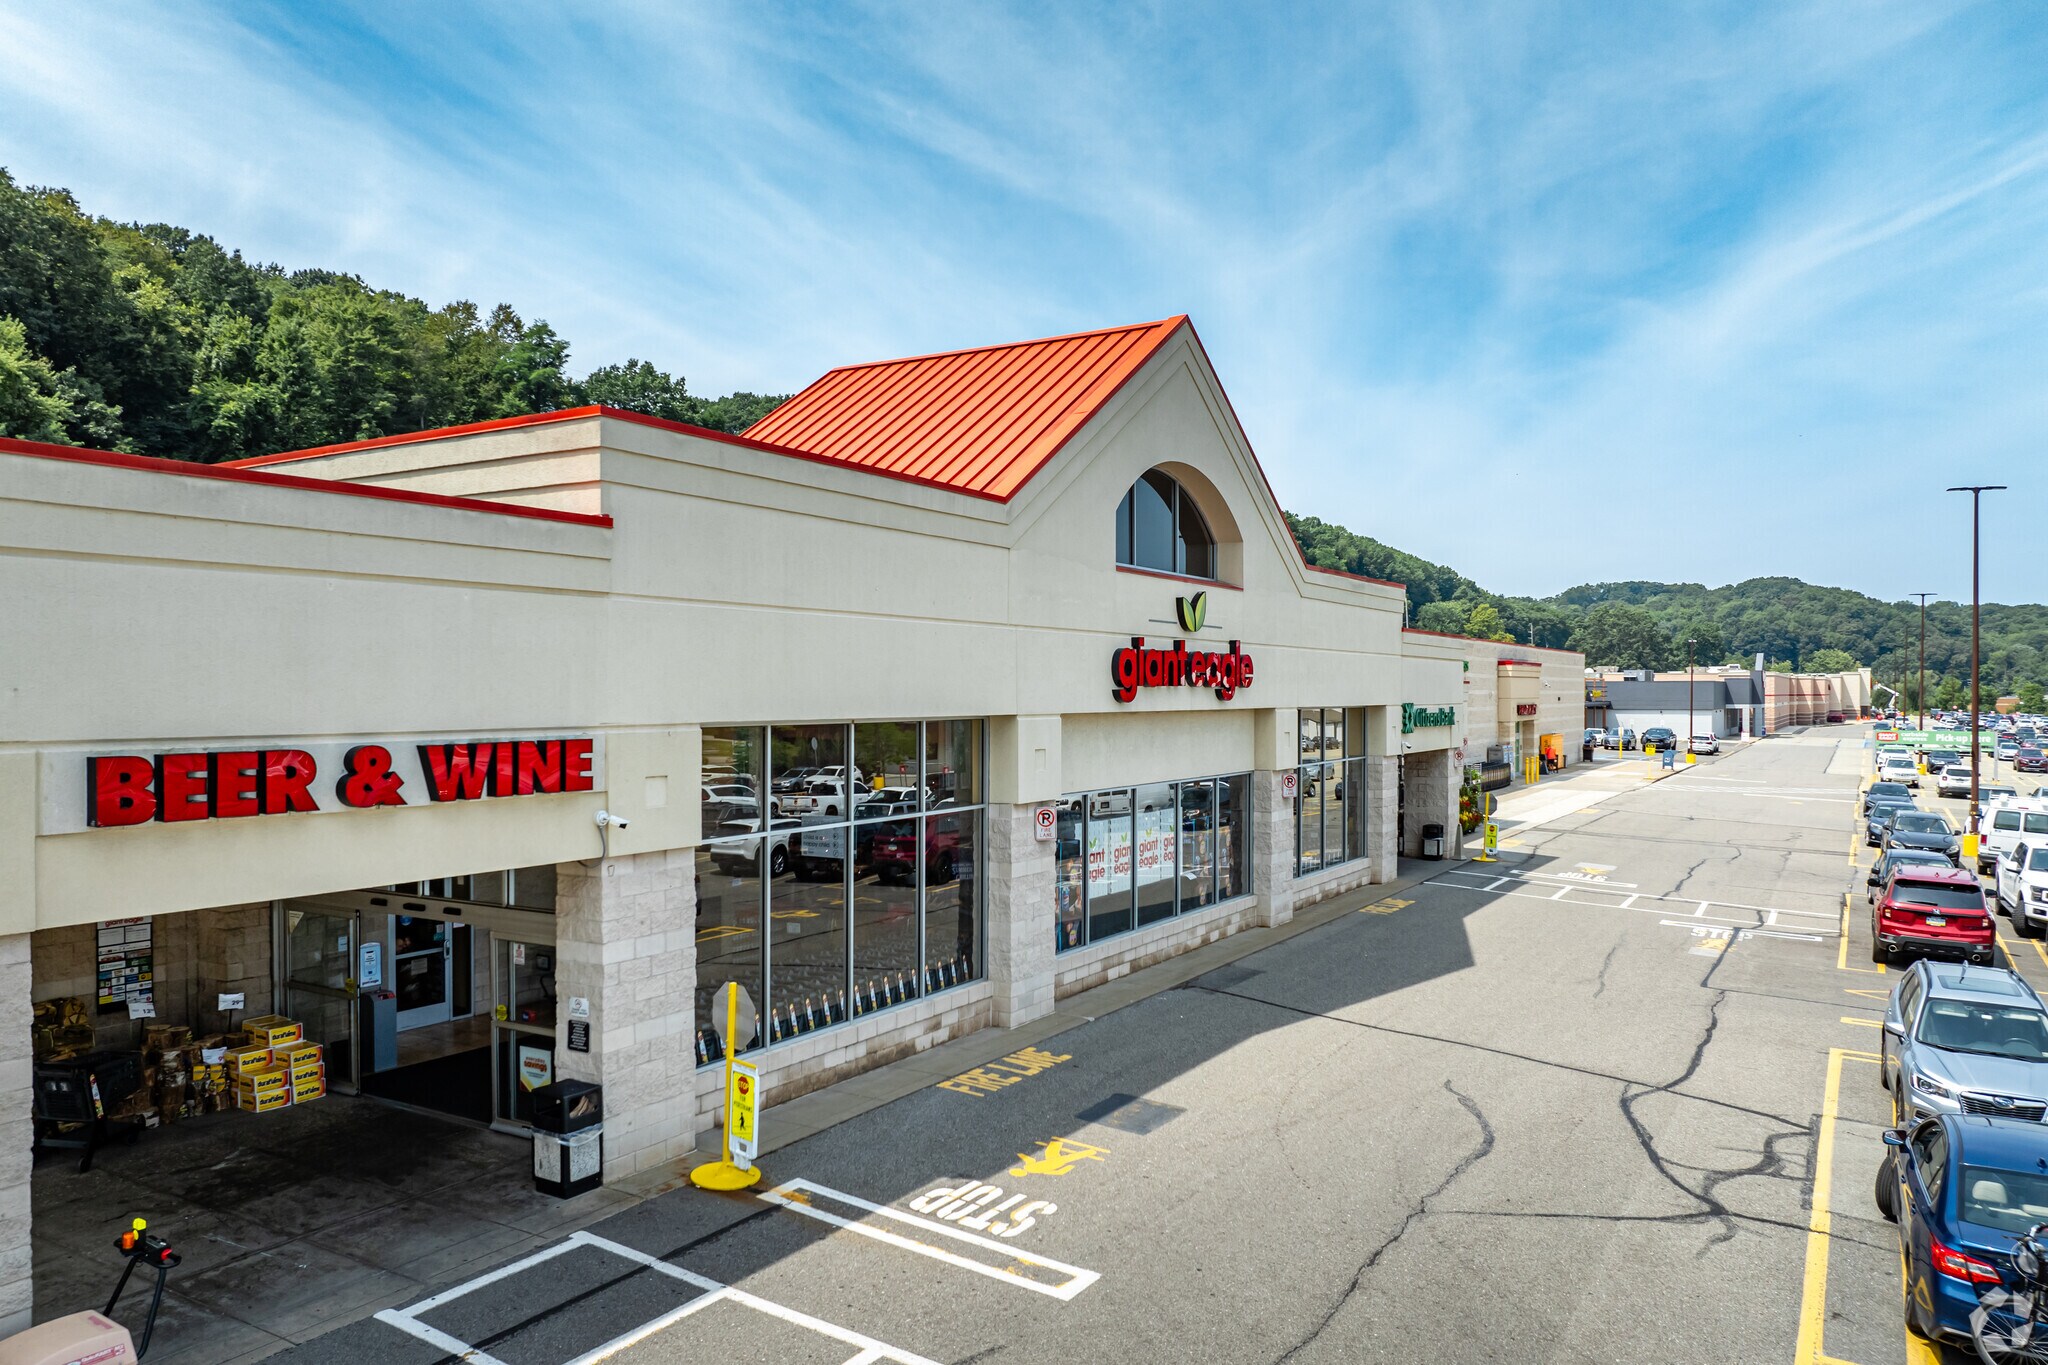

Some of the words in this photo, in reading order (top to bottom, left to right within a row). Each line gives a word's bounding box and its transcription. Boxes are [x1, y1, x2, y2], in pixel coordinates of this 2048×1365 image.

[1112, 637, 1189, 703] giant
[1185, 640, 1254, 701] eagle
[1936, 735, 1968, 744] Pick-up
[87, 749, 320, 827] BEER
[336, 744, 407, 808] &
[416, 738, 594, 801] WINE
[1114, 845, 1131, 863] gian
[1139, 837, 1158, 857] giant
[1114, 860, 1131, 876] eagl
[1139, 853, 1158, 869] eagle
[936, 1067, 1022, 1097] FIRE
[987, 1046, 1072, 1076] LANE
[909, 1180, 1058, 1238] STOP
